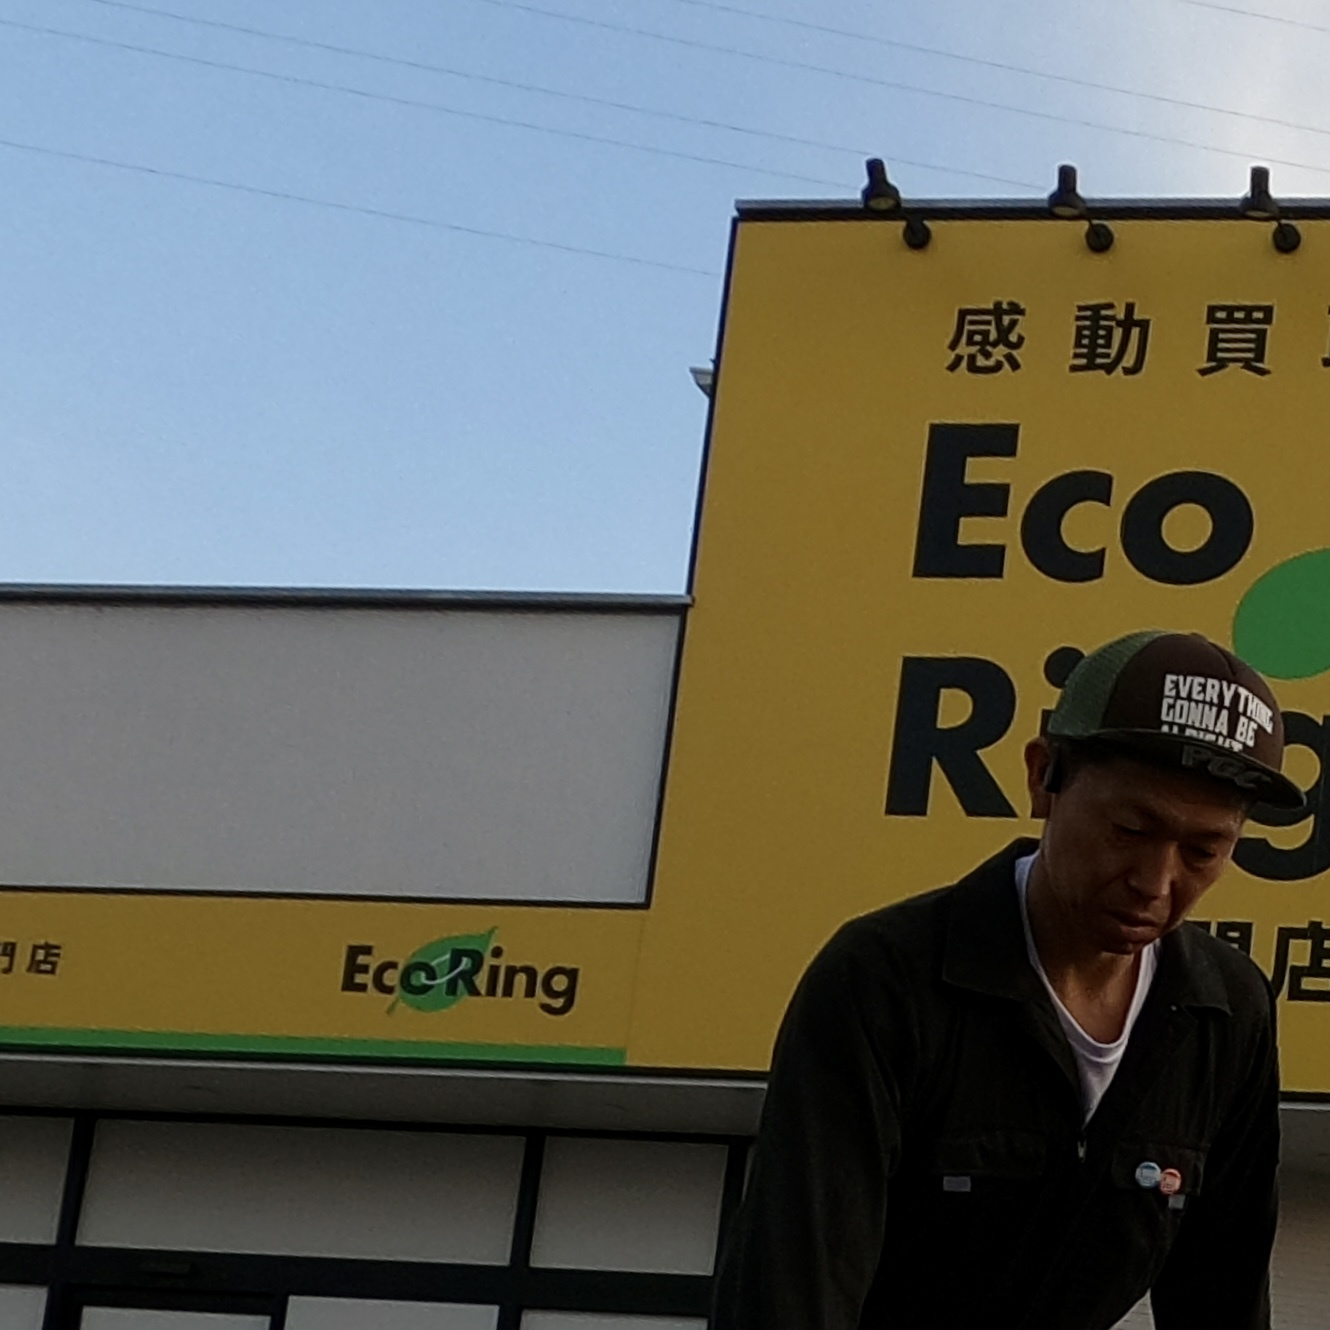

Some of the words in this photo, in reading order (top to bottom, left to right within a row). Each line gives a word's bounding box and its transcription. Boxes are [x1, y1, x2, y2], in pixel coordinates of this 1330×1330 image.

[911, 422, 1254, 586] Eco
[1161, 697, 1229, 736] GONNA
[1235, 715, 1258, 747] BE
